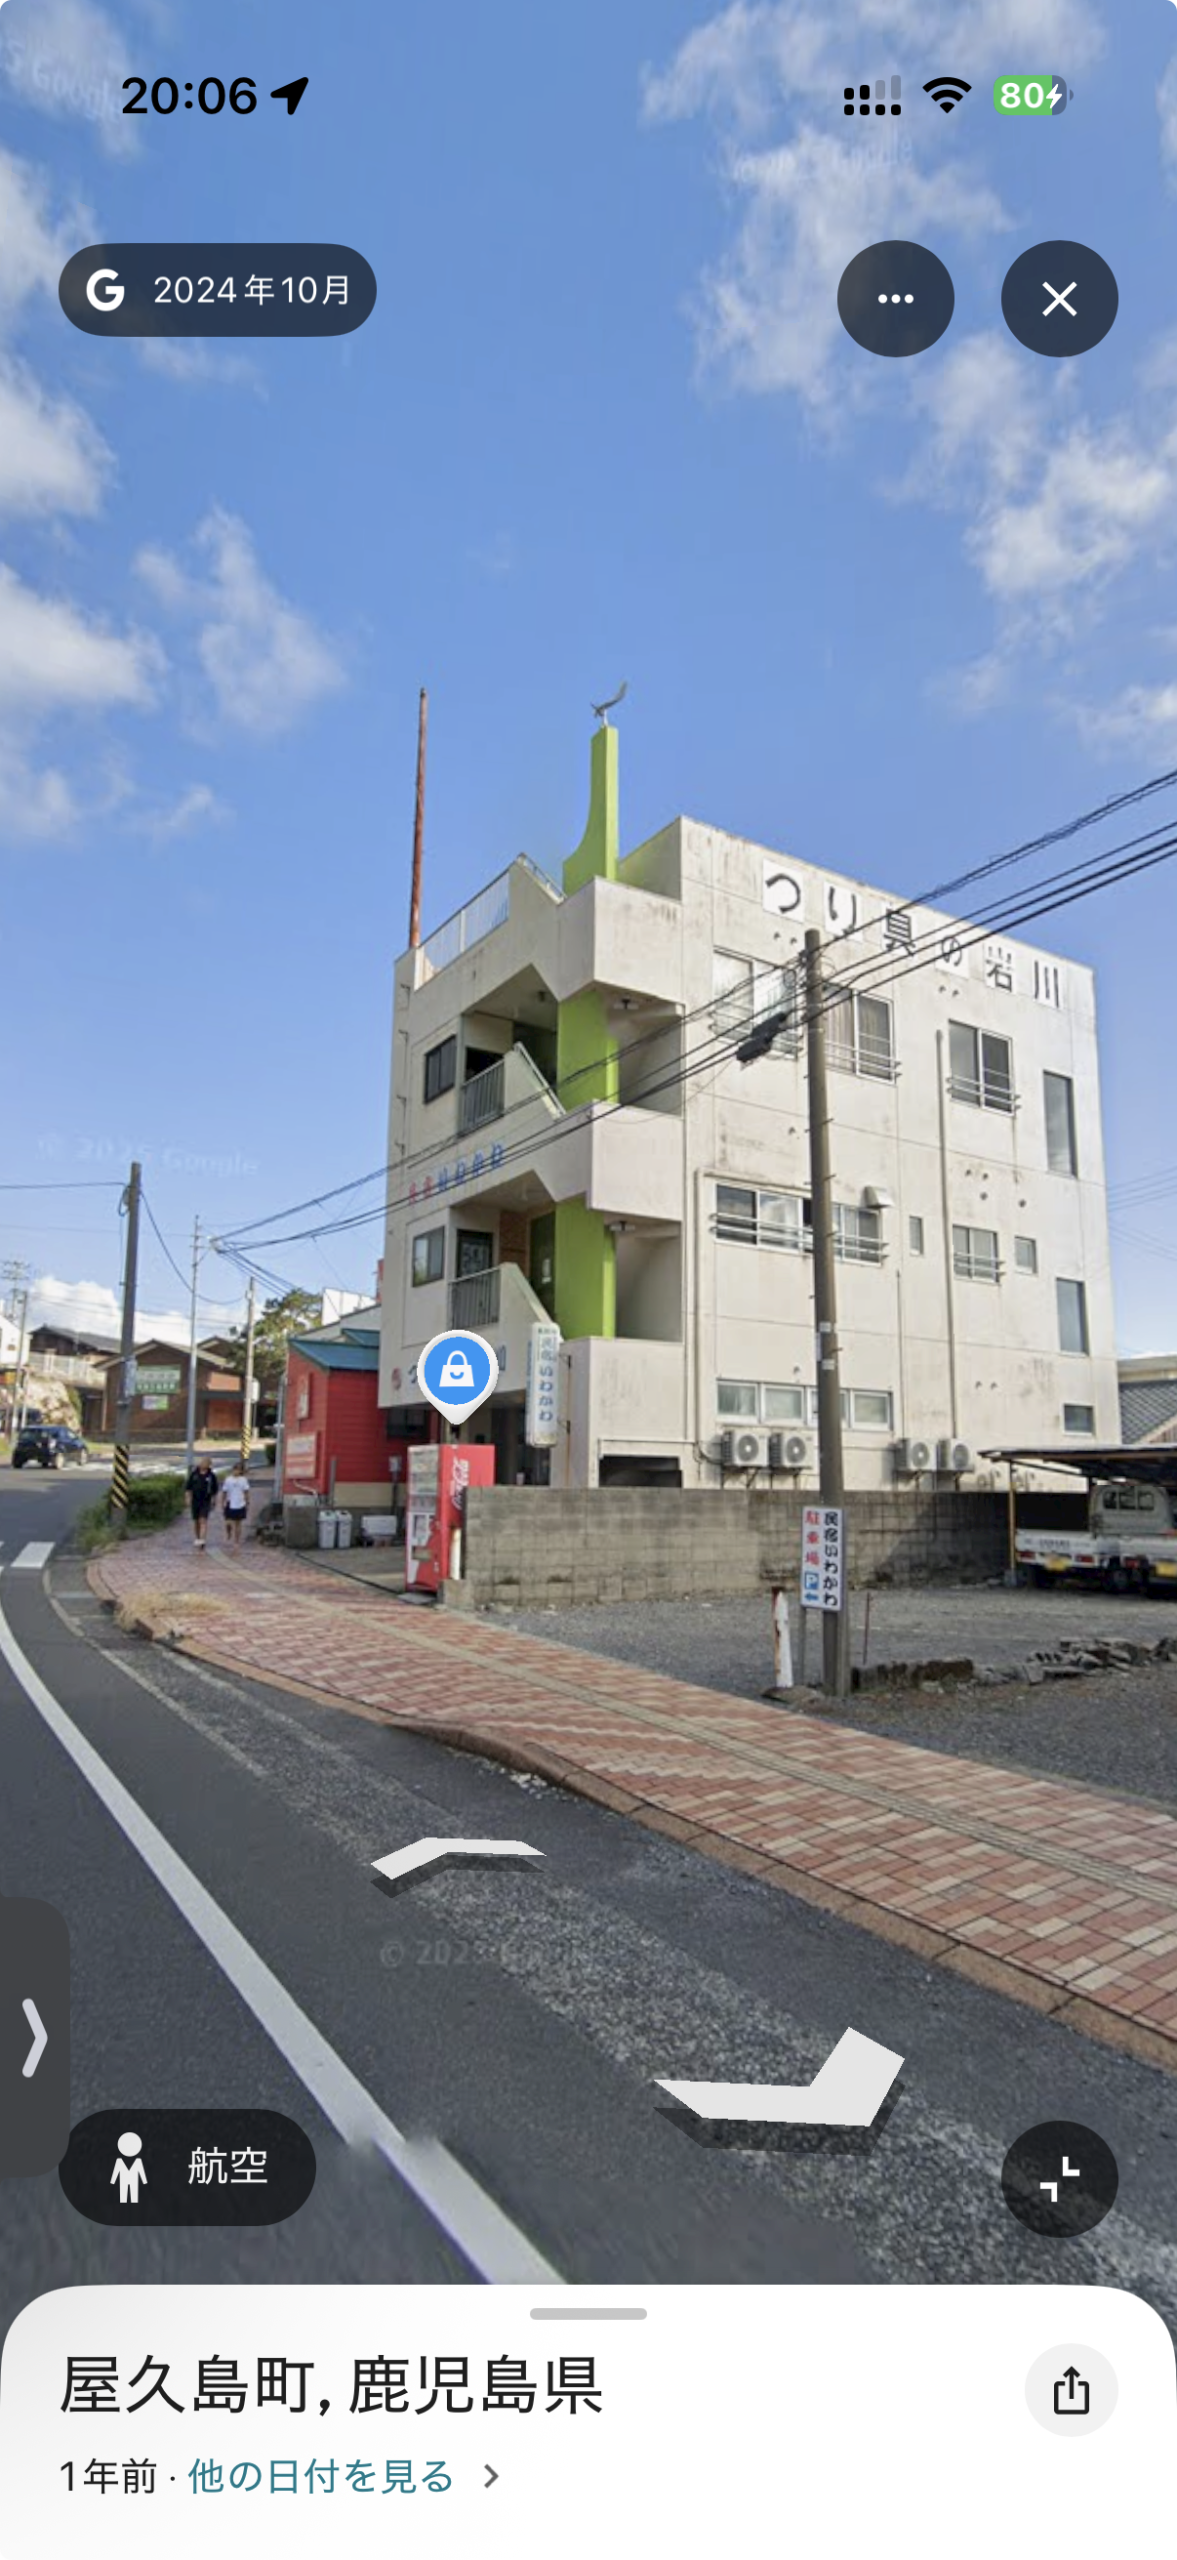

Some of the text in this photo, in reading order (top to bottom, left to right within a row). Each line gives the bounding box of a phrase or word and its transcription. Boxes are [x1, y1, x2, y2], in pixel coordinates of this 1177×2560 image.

[765, 872, 1060, 1008] つり具の岩川
[823, 1511, 839, 1606] 民宿いわかわ
